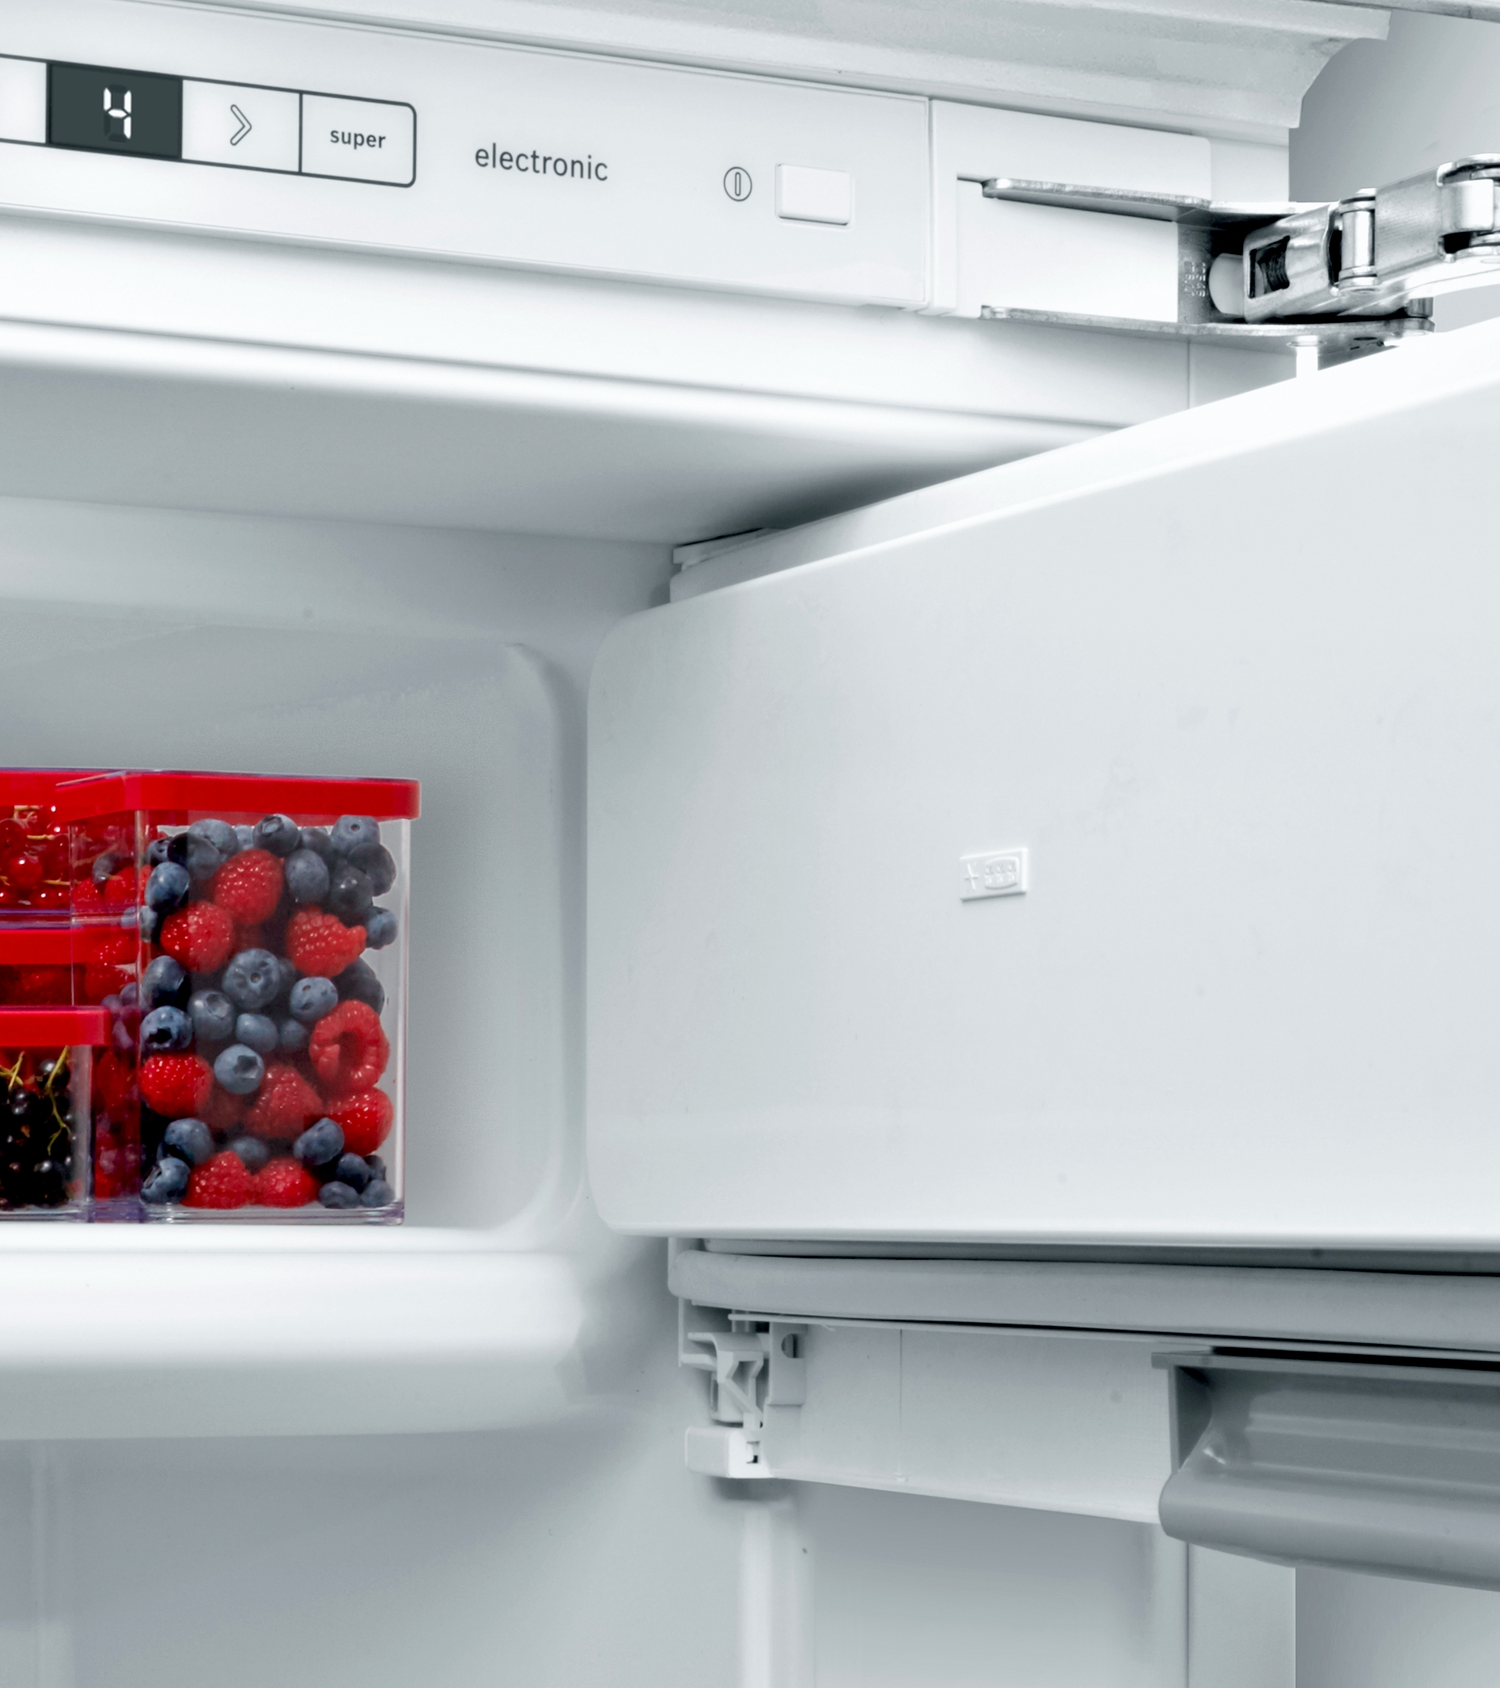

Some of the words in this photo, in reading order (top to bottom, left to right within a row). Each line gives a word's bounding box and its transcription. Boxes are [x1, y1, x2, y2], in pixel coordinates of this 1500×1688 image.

[103, 87, 132, 139] 4
[330, 129, 387, 150] super
[474, 142, 608, 182] electronic
